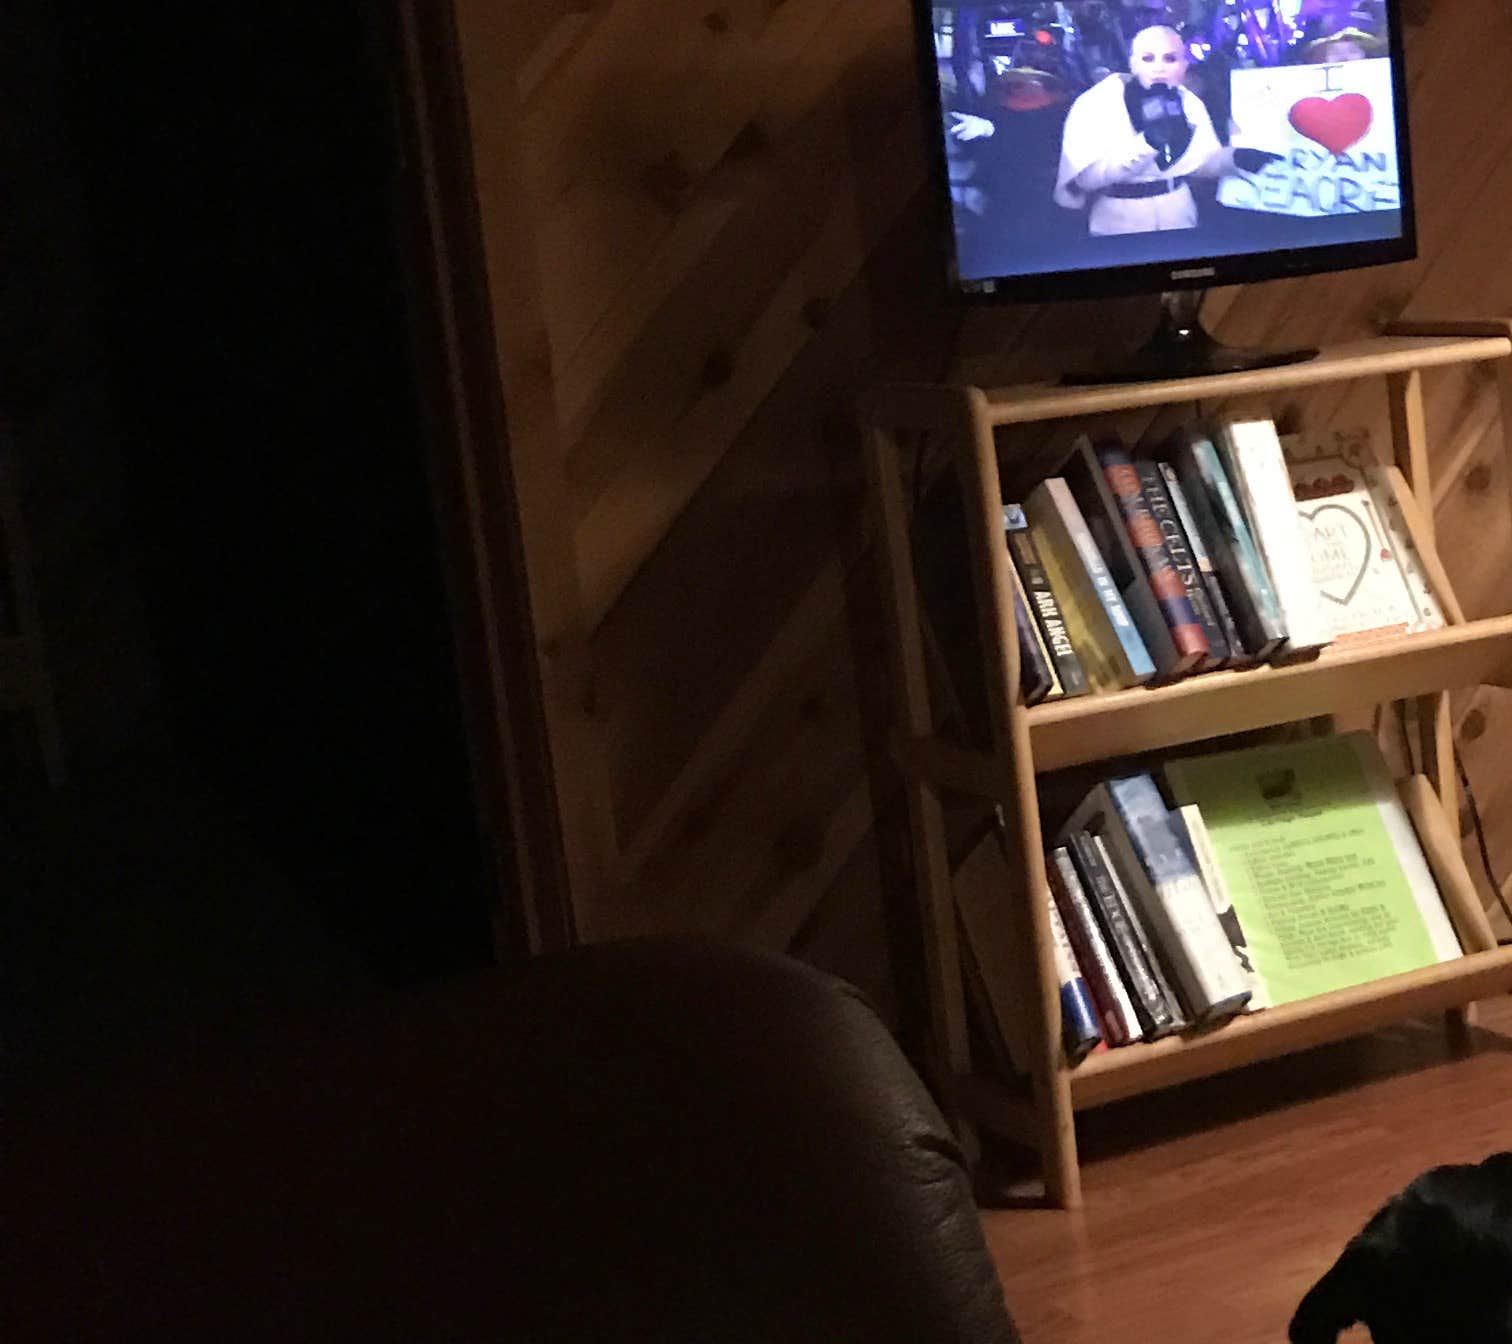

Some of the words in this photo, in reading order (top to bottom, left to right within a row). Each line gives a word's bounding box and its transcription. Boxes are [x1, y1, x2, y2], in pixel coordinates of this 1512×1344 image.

[1315, 65, 1344, 93] I
[1289, 146, 1388, 173] RYAN
[1143, 475, 1169, 515] THE
[1159, 518, 1195, 587] CELTS
[1044, 619, 1075, 657] ANGEL
